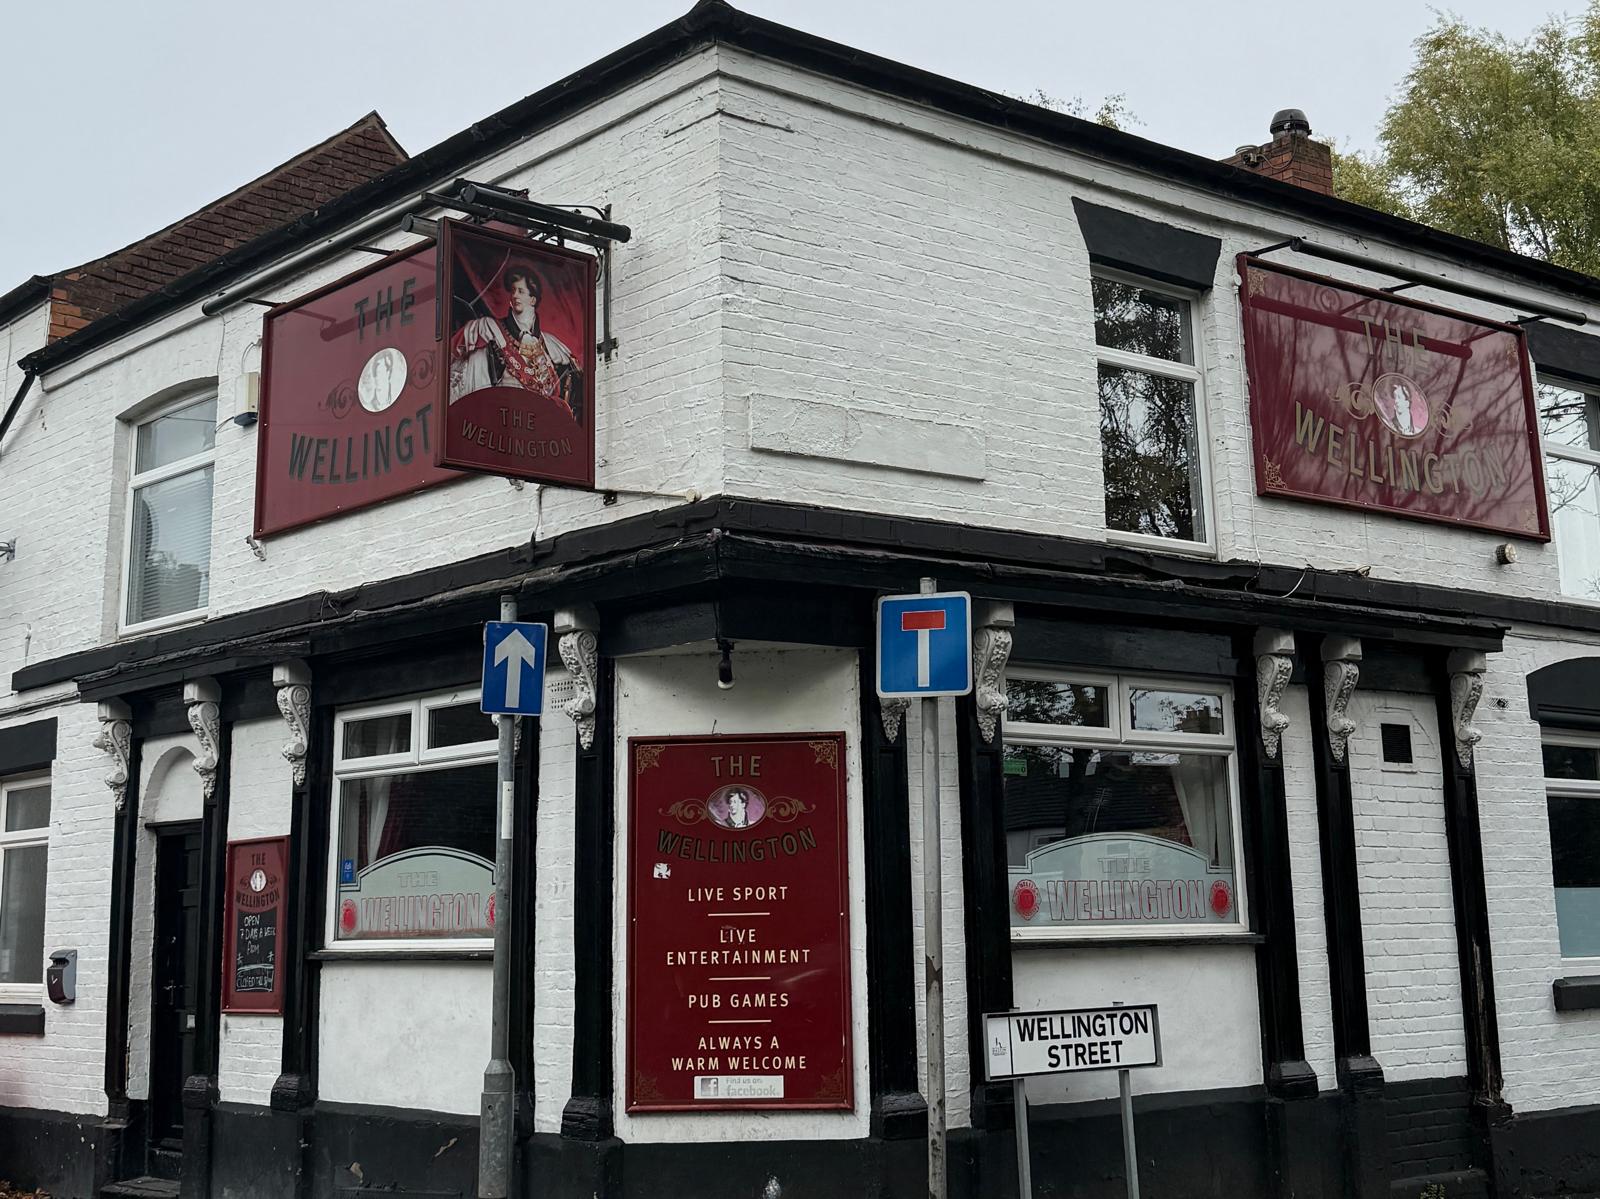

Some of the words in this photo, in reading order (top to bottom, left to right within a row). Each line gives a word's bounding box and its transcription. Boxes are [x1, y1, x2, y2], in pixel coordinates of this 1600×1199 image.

[354, 277, 417, 339] THE
[1356, 314, 1430, 359] THE
[500, 407, 536, 430] THE
[288, 403, 433, 484] WELLINGT
[461, 419, 573, 457] WELLINGTON
[1295, 400, 1508, 495] WELLINGTON
[711, 755, 763, 777] THE
[657, 826, 817, 863] WELLINGTON
[252, 852, 266, 866] THE
[1098, 857, 1152, 873] THE
[398, 871, 438, 888] THE
[236, 888, 280, 908] WELLINGTON
[688, 887, 724, 902] LIVE
[733, 886, 789, 901] SPORT
[1047, 879, 1206, 921] WELLINGTON
[244, 914, 260, 927] OPEN
[361, 892, 481, 932] WELLINGTON
[720, 928, 756, 943] LIVE
[667, 949, 811, 965] ENTERTAINMENT
[688, 994, 721, 1008] PUB
[730, 993, 789, 1007] GAMES
[1016, 1011, 1149, 1042] WELLINGTON
[698, 1036, 763, 1050] ALWAYS
[770, 1035, 779, 1049] A
[671, 1057, 719, 1071] WARM
[727, 1055, 807, 1070] WELCOME
[1047, 1040, 1123, 1068] STREET
[727, 1084, 776, 1097] facebook
